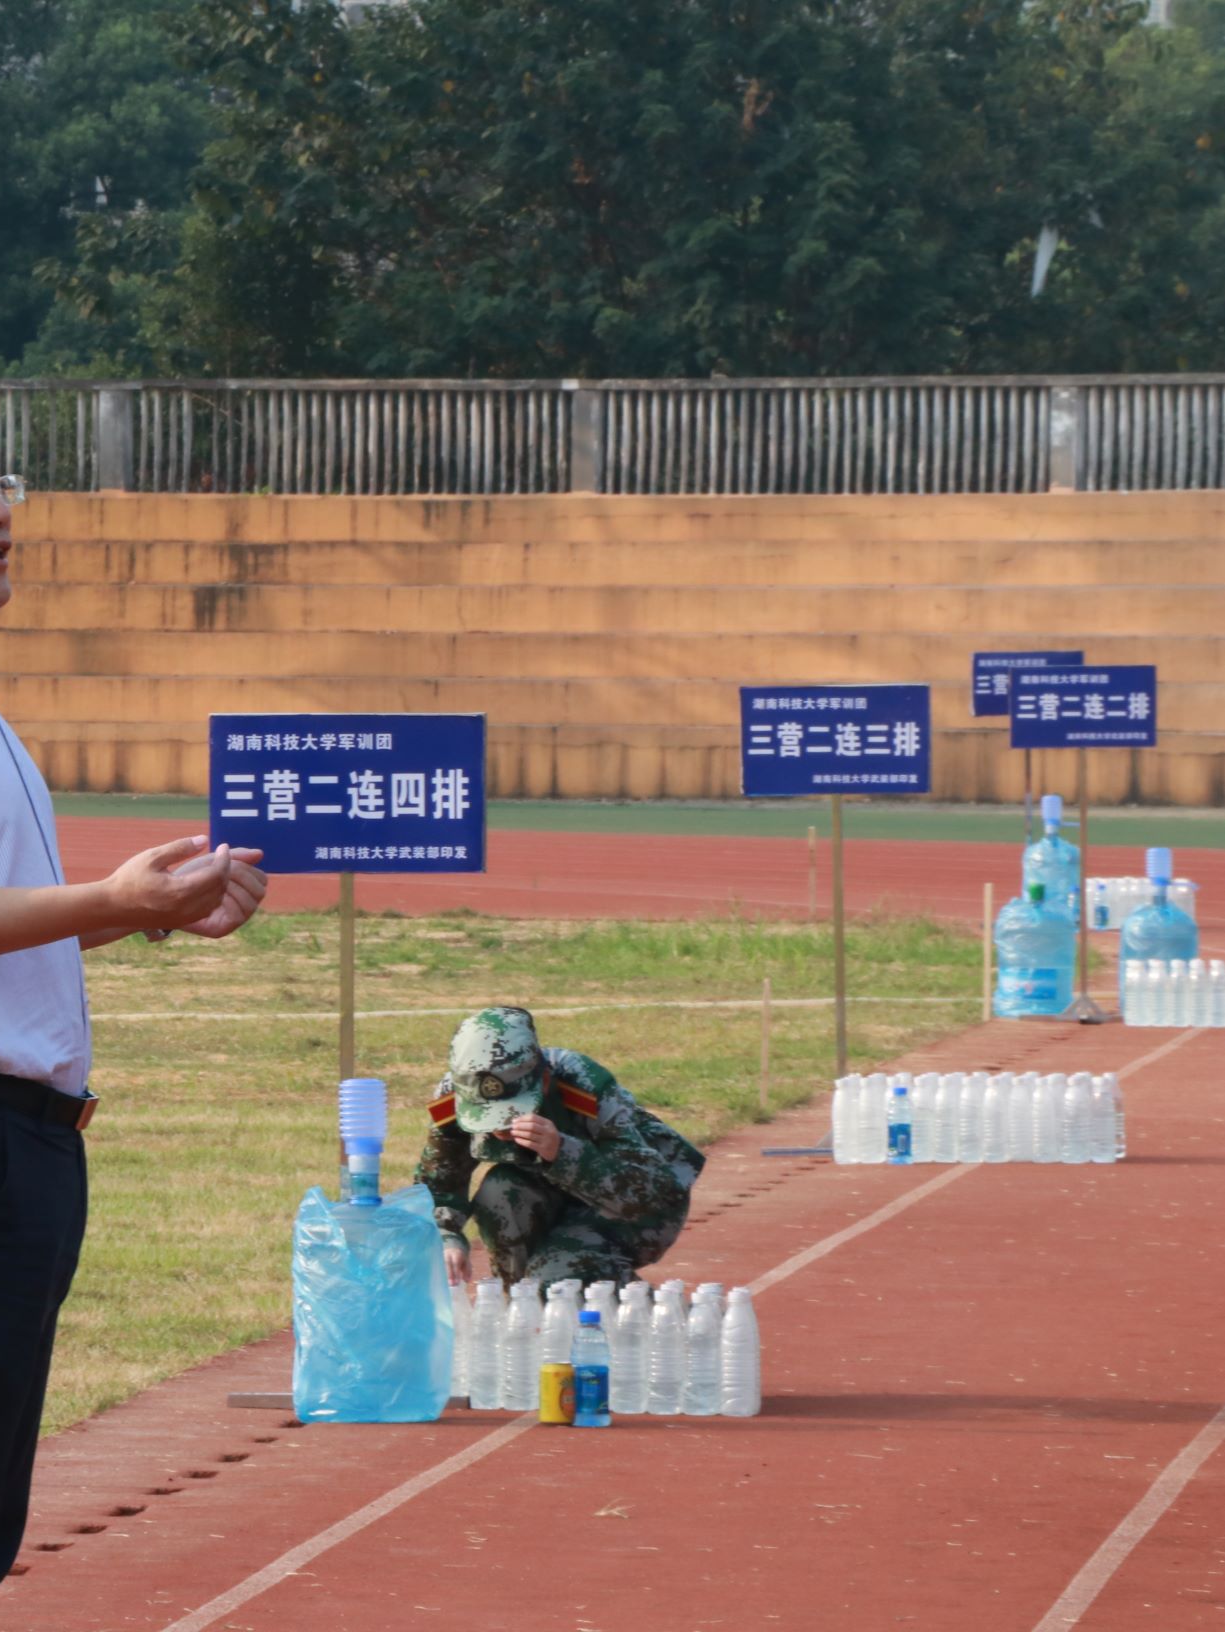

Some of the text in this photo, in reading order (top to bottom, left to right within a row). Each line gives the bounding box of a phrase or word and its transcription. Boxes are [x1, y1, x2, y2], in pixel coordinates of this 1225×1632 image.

[1016, 692, 1151, 720] 三营二连二排
[226, 732, 393, 752] 湖南科技大学军训团
[748, 721, 921, 758] 三营二连三排
[221, 768, 471, 821] 三营二连四排
[314, 846, 468, 860] 湖南科技大学武装部印发
